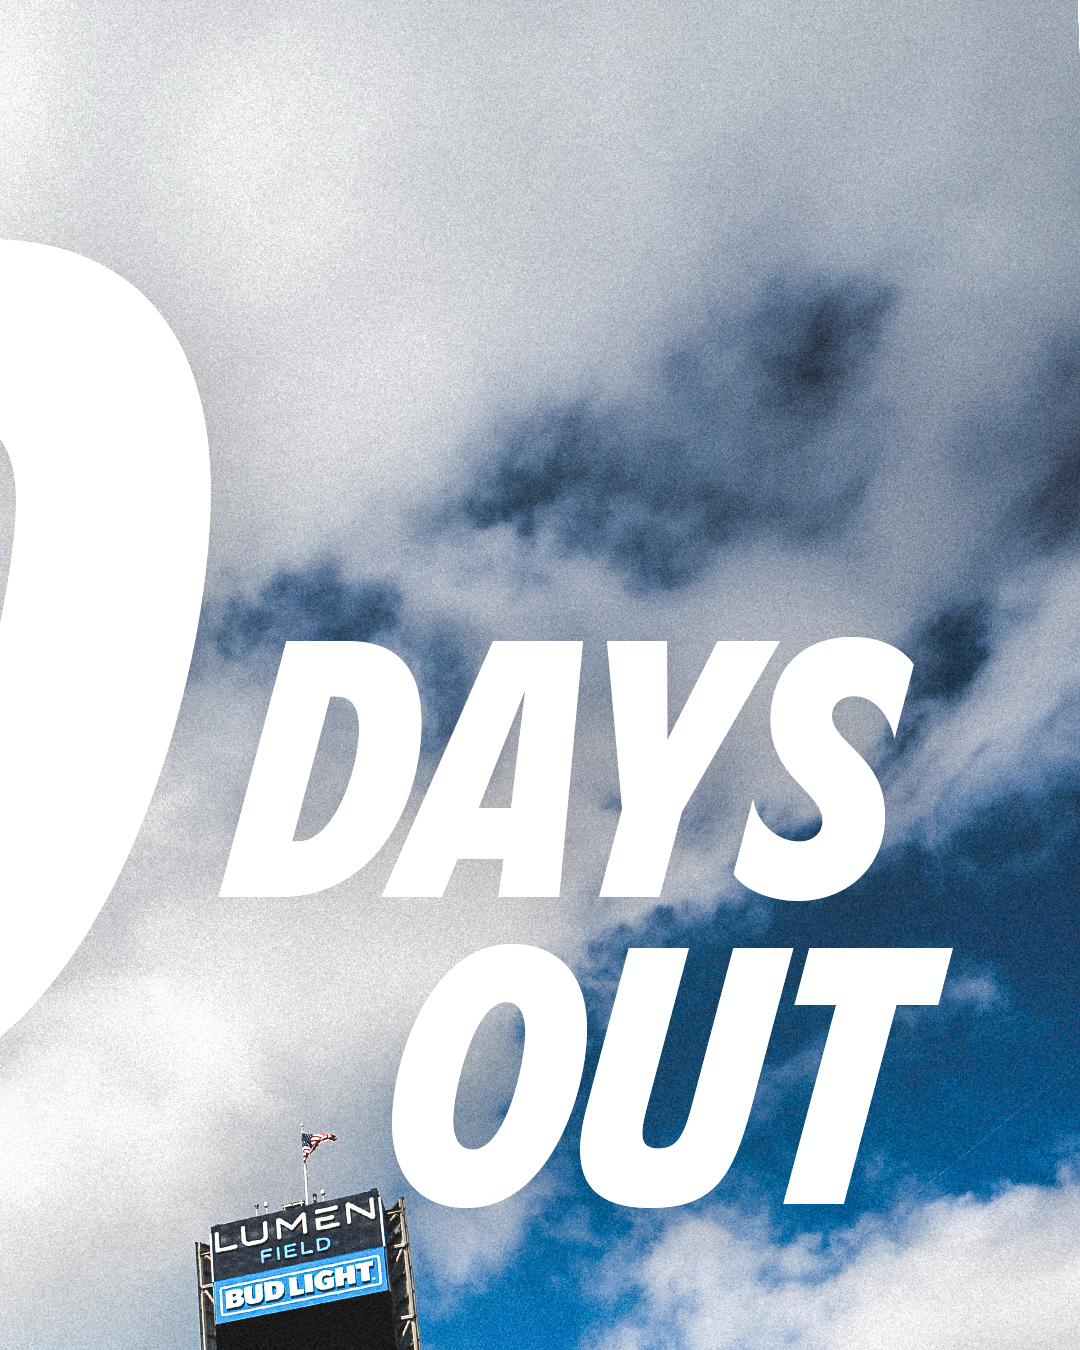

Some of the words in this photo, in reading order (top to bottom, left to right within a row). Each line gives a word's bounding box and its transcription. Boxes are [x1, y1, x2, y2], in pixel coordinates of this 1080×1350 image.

[214, 1197, 376, 1253] LUMEN
[260, 1237, 331, 1264] FIELD
[225, 1281, 285, 1310] BUD
[288, 1260, 374, 1297] LIGHT
